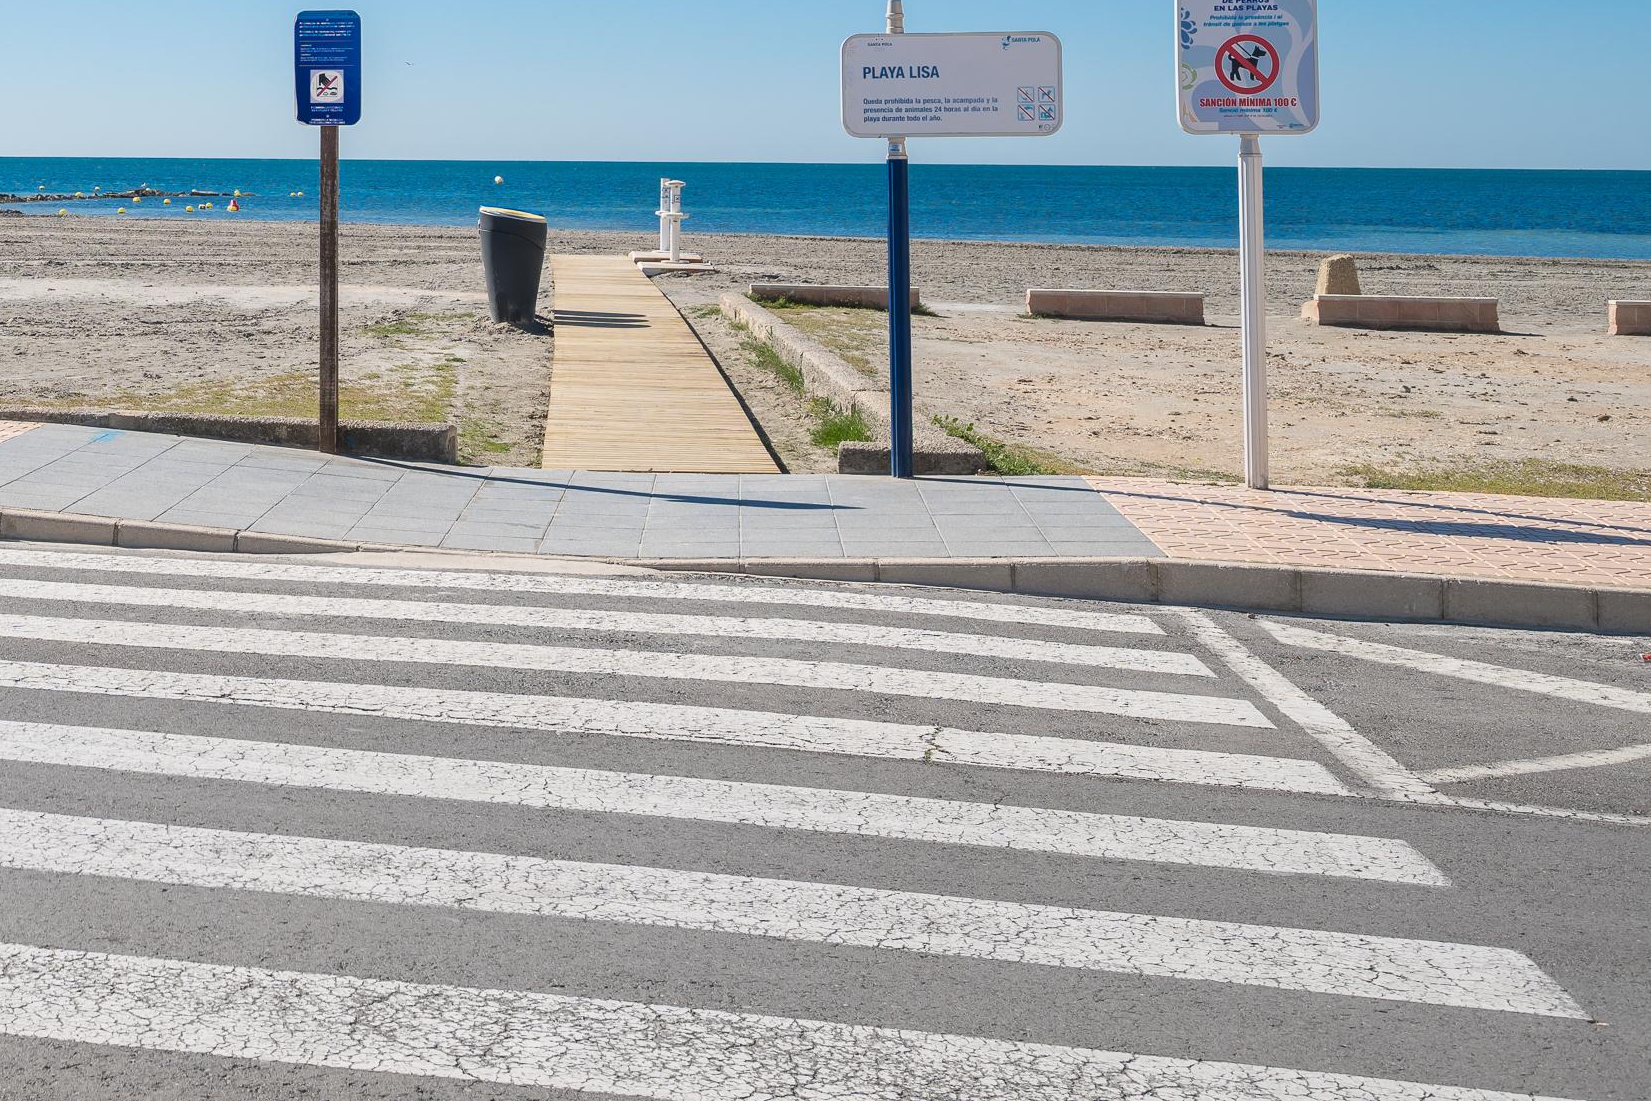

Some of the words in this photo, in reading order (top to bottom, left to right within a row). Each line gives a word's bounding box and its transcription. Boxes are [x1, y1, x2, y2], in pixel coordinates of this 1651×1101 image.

[863, 66, 905, 79] PLAYA
[909, 65, 940, 78] LISA
[884, 97, 913, 105] prohibida
[1200, 97, 1236, 107] SANCIÓN
[1239, 96, 1271, 107] MÍNIMA
[1274, 98, 1289, 107] 100
[1291, 98, 1297, 106] €
